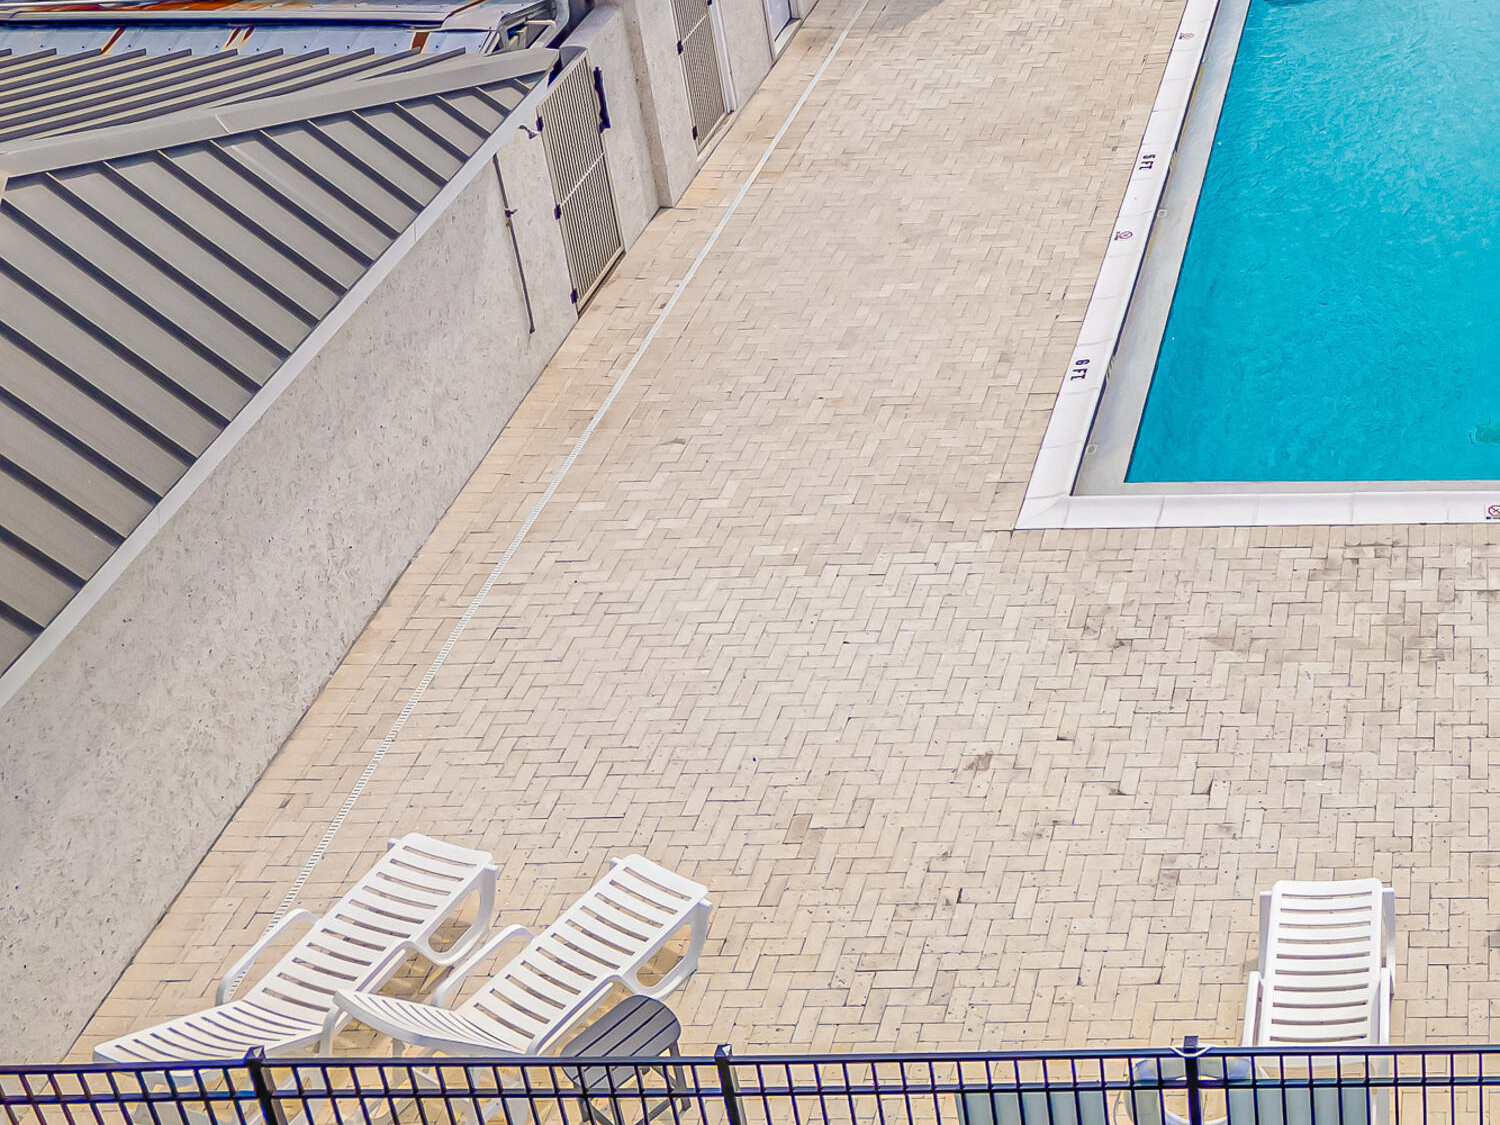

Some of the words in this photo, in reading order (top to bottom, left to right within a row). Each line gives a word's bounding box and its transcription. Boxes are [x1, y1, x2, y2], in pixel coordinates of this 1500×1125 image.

[1139, 161, 1154, 170] FT
[1075, 358, 1090, 366] 6
[1070, 368, 1088, 381] FT
